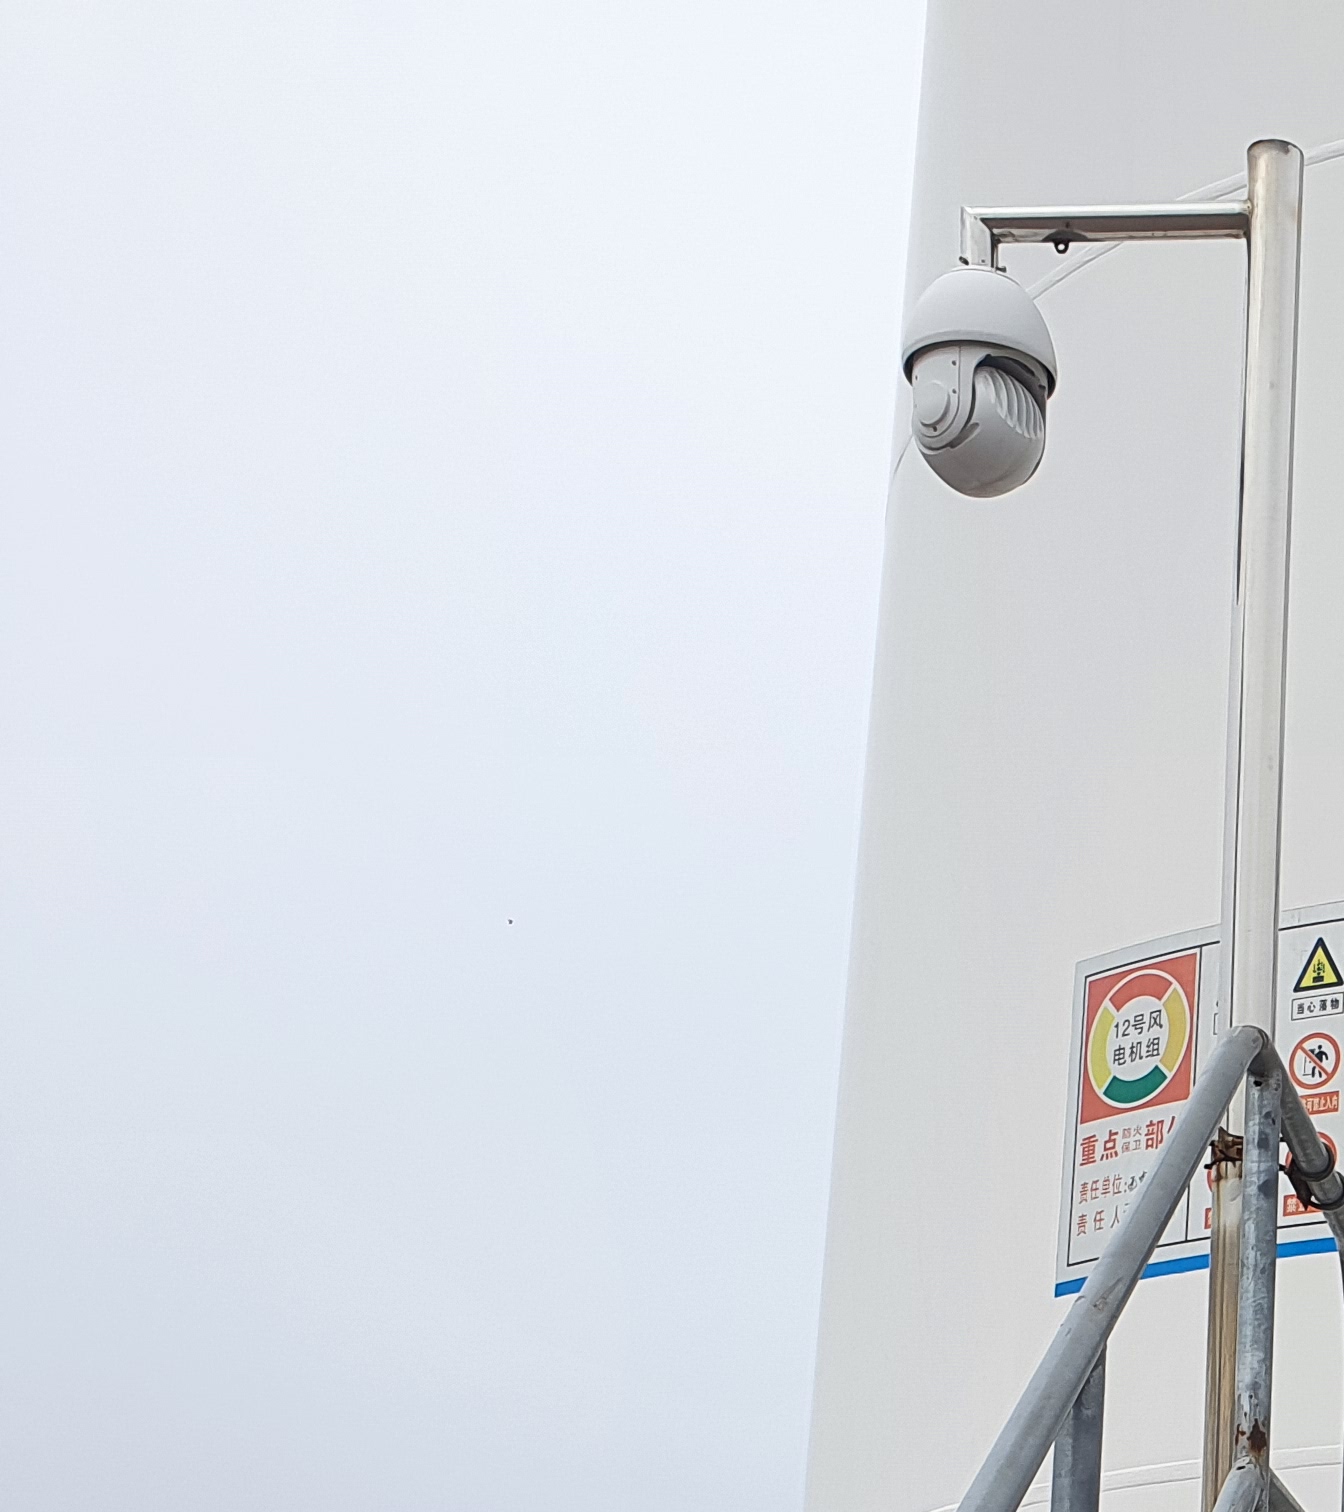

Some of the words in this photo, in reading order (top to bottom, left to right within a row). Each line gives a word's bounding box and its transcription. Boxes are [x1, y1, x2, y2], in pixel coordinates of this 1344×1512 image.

[1296, 997, 1340, 1015] 当心落物
[1113, 1009, 1164, 1039] 12号风
[1112, 1037, 1161, 1066] 电机组
[1079, 1129, 1119, 1167] 重点
[1145, 1116, 1176, 1150] 部
